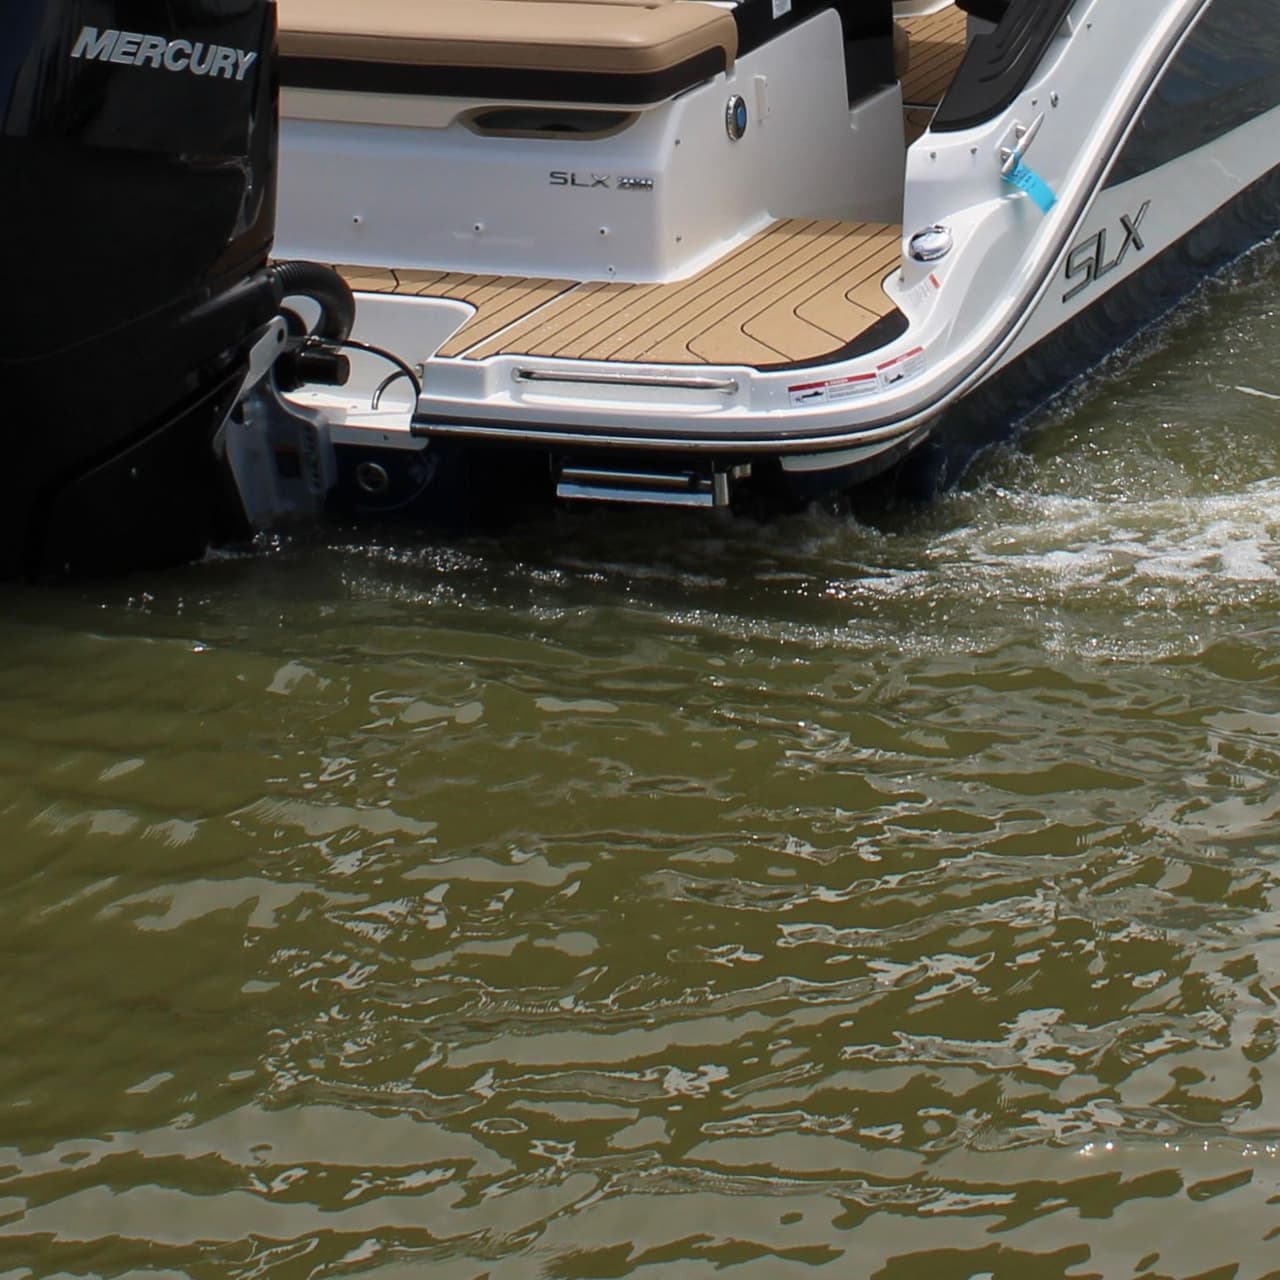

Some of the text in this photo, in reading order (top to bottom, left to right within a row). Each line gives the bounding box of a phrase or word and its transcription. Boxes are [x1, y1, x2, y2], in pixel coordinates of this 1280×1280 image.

[70, 26, 258, 81] MERCURY
[549, 171, 610, 189] SLX
[1062, 200, 1152, 304] SLX
